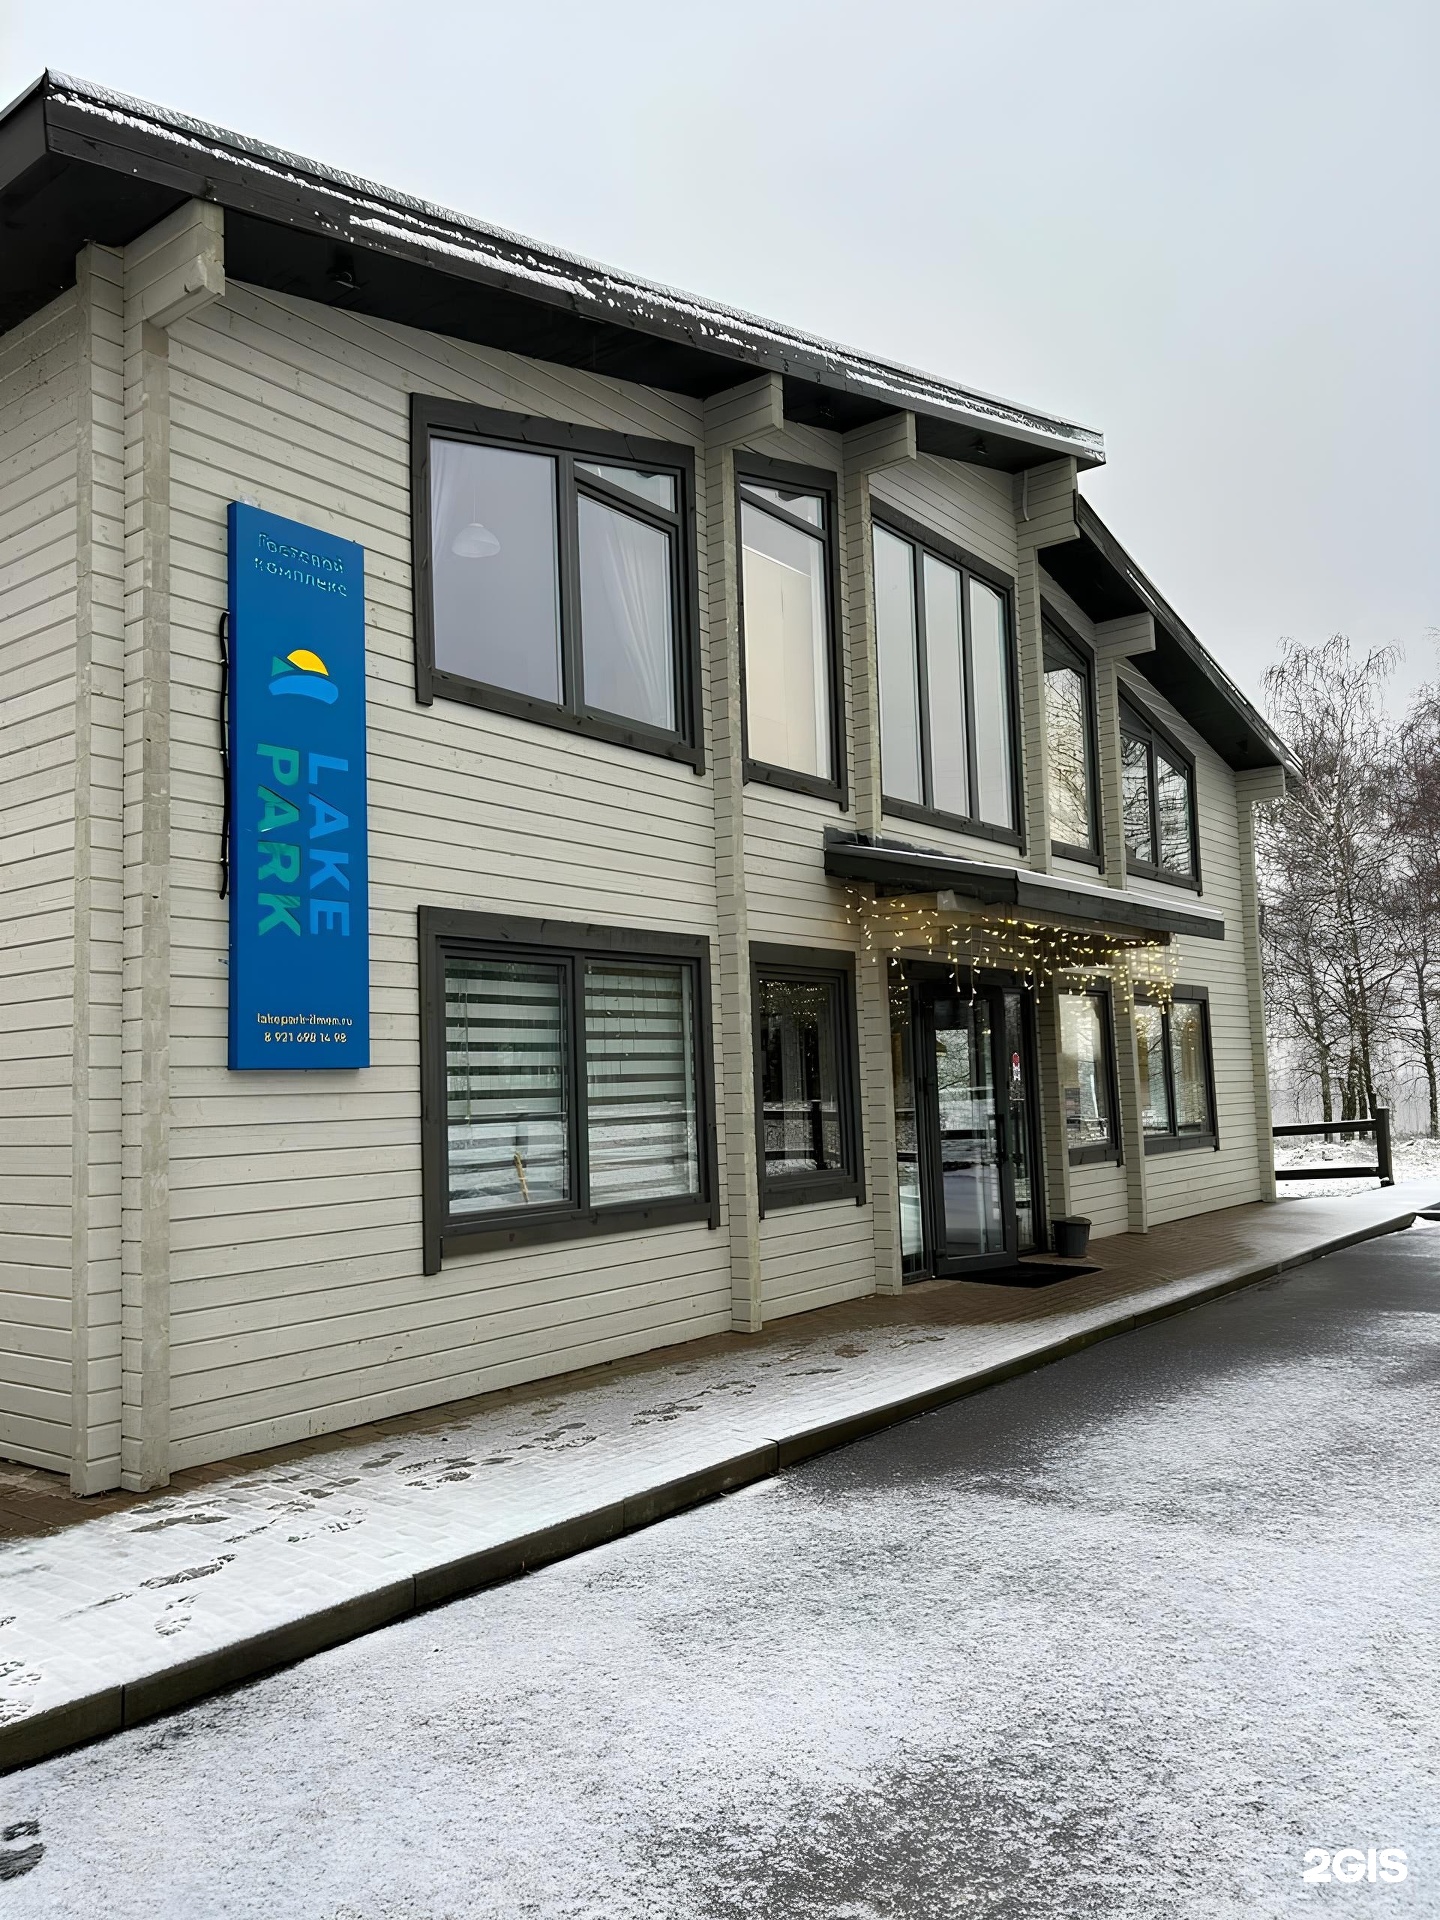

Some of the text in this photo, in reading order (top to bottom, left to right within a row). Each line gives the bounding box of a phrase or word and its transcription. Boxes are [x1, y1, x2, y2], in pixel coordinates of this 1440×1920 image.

[256, 743, 301, 937] PARK
[308, 752, 350, 937] LAKE
[264, 1032, 272, 1042] 8
[275, 1032, 293, 1042] 921
